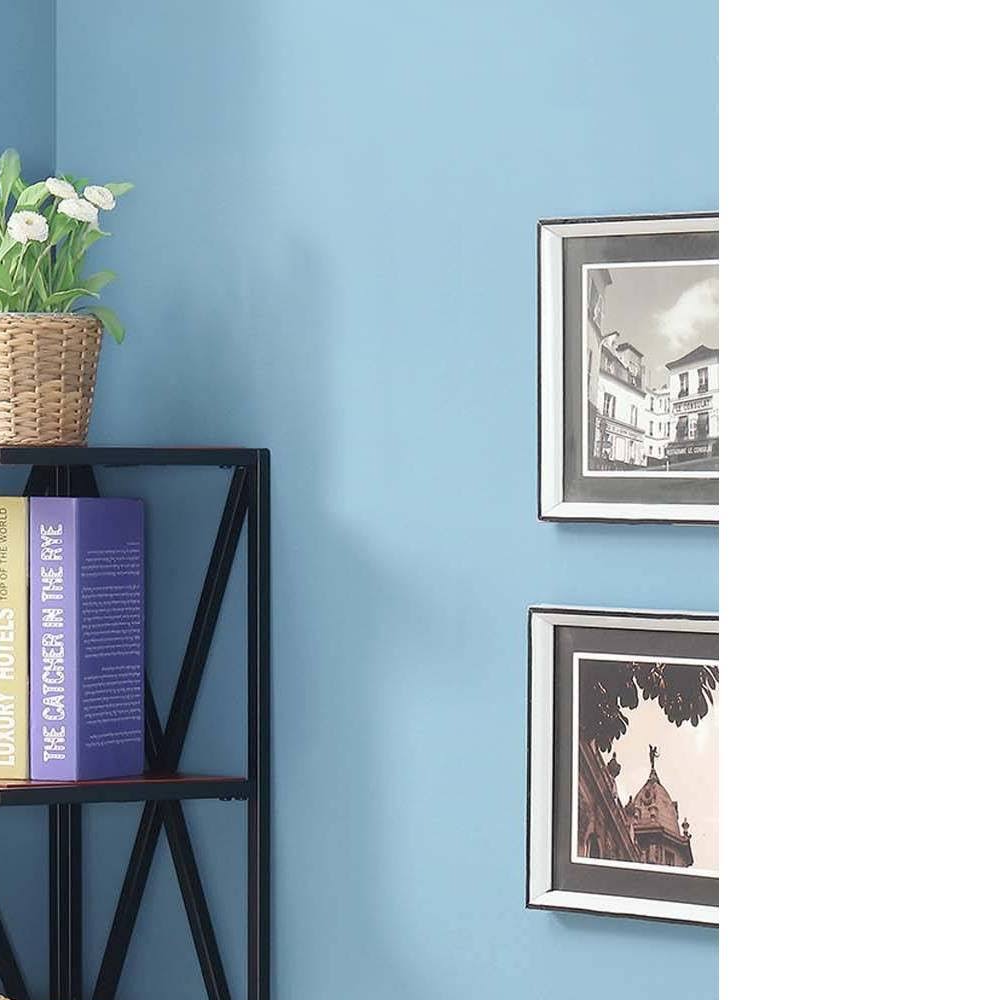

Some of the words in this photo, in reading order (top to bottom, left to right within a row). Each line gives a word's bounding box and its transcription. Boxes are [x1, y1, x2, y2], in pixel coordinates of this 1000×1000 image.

[0, 507, 8, 543] WORLD
[40, 523, 64, 561] RYE
[0, 546, 8, 564] THE
[0, 567, 8, 580] OF
[0, 583, 8, 600] TOP
[40, 565, 64, 602] THE
[41, 607, 64, 628] IN
[41, 632, 66, 721] CATCHER
[42, 725, 66, 762] THE
